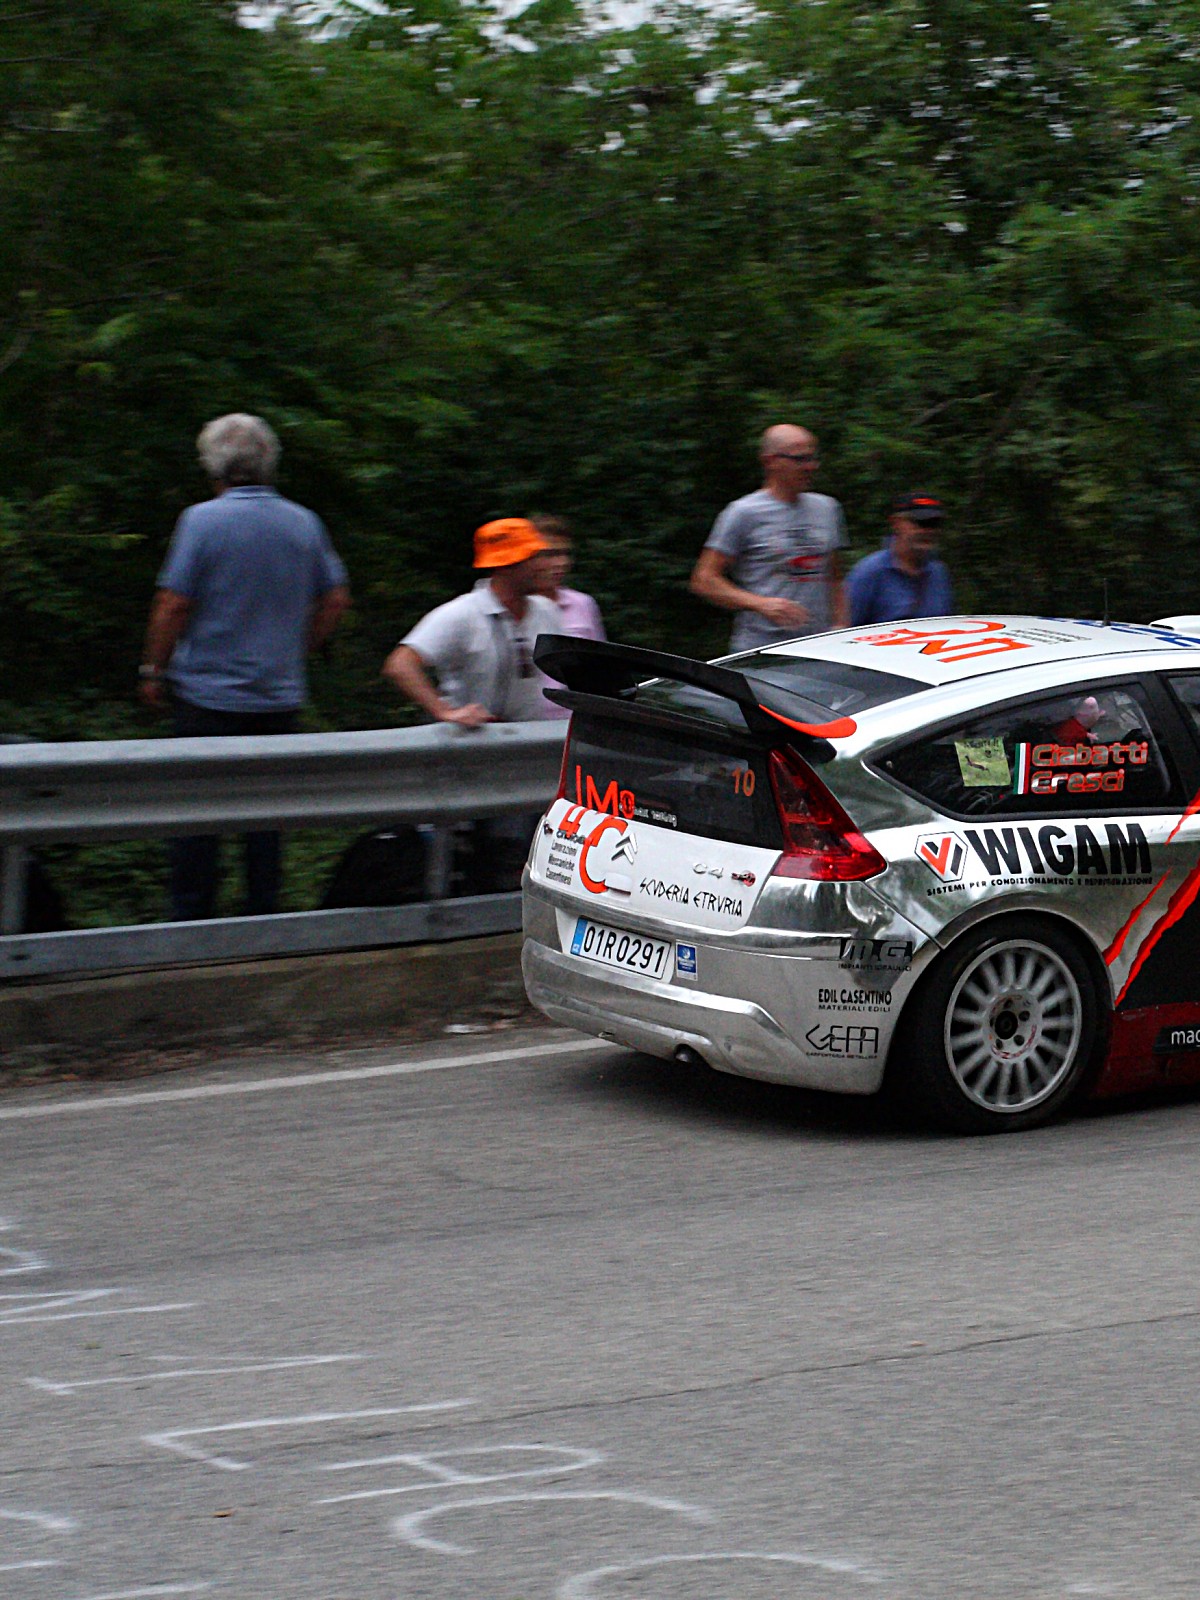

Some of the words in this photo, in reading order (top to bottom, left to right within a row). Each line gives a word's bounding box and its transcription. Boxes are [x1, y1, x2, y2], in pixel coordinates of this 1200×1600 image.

[1032, 741, 1148, 767] Ciabatti
[731, 767, 756, 797] 10
[1031, 769, 1125, 794] Cresci
[964, 823, 1153, 876] WIGAM
[692, 862, 724, 880] C4
[926, 883, 966, 897] SISTEMI
[583, 926, 665, 973] 01R0291
[818, 988, 838, 1003] EDIL
[840, 988, 892, 1005] CASENTINO
[818, 1004, 865, 1012] MATERIALI
